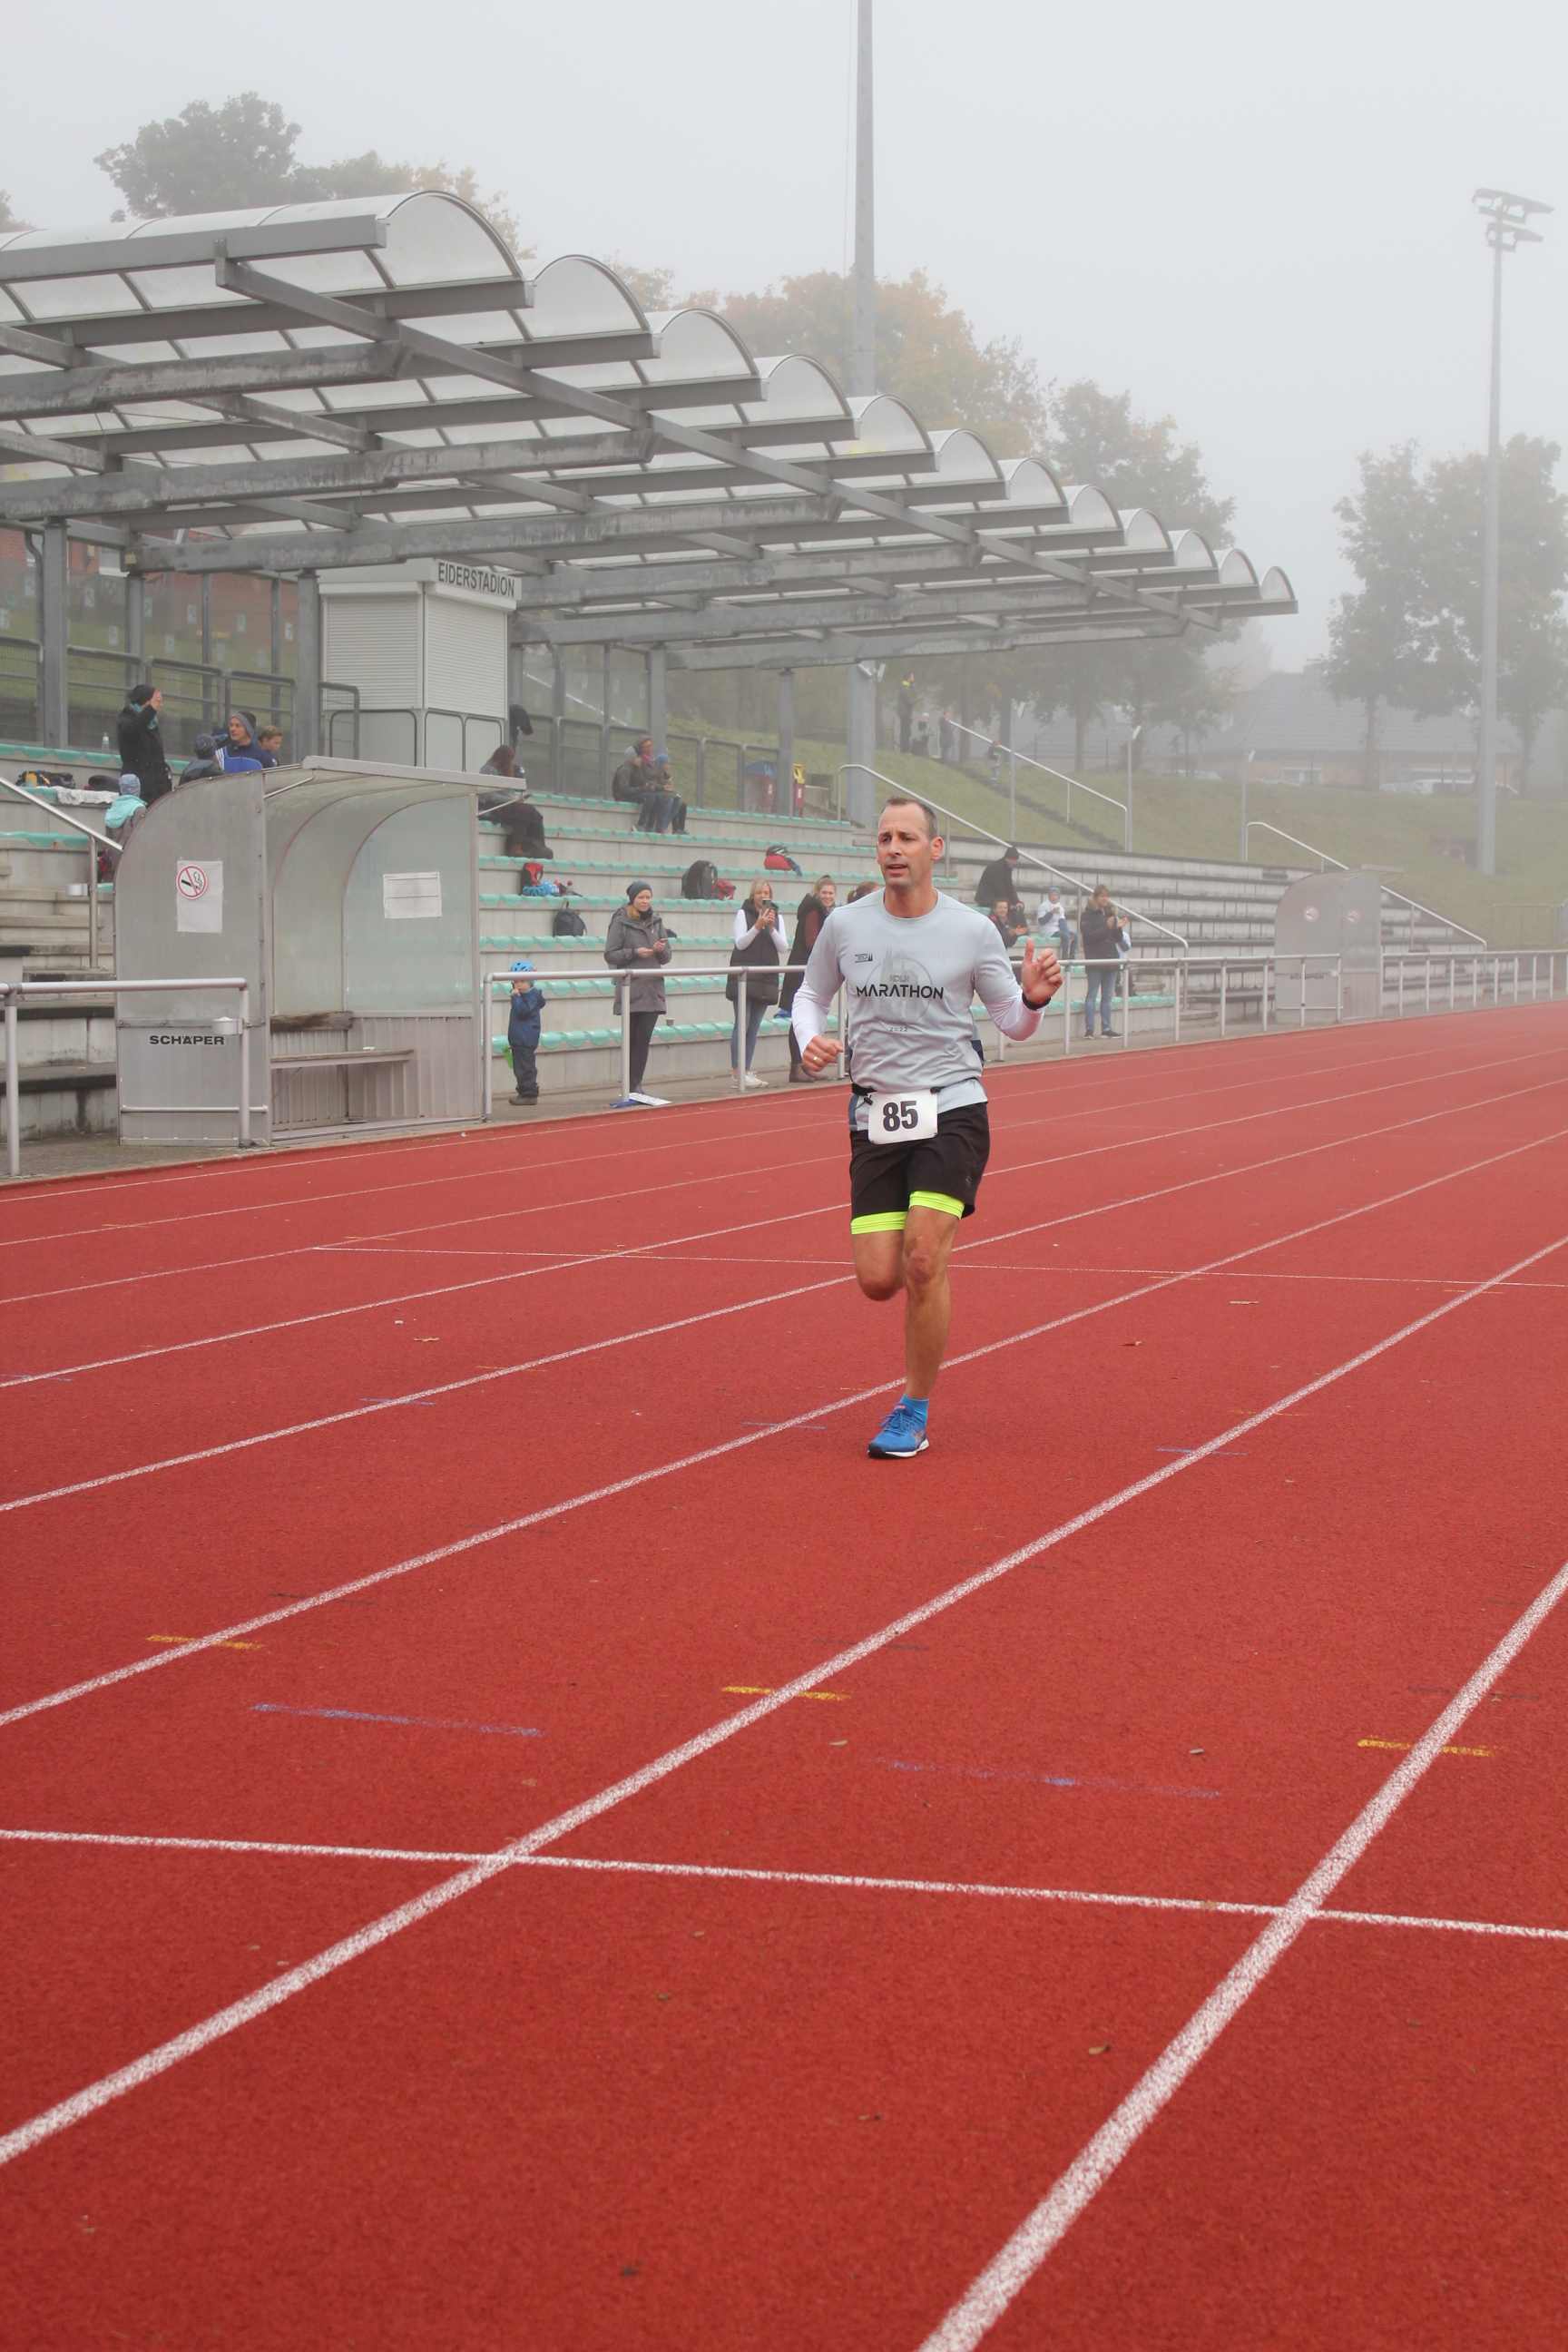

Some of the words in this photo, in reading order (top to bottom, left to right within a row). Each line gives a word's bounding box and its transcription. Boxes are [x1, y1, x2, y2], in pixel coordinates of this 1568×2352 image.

[438, 562, 514, 598] EIDERSTADION
[856, 984, 944, 999] MARATHON
[883, 1100, 918, 1132] 85
